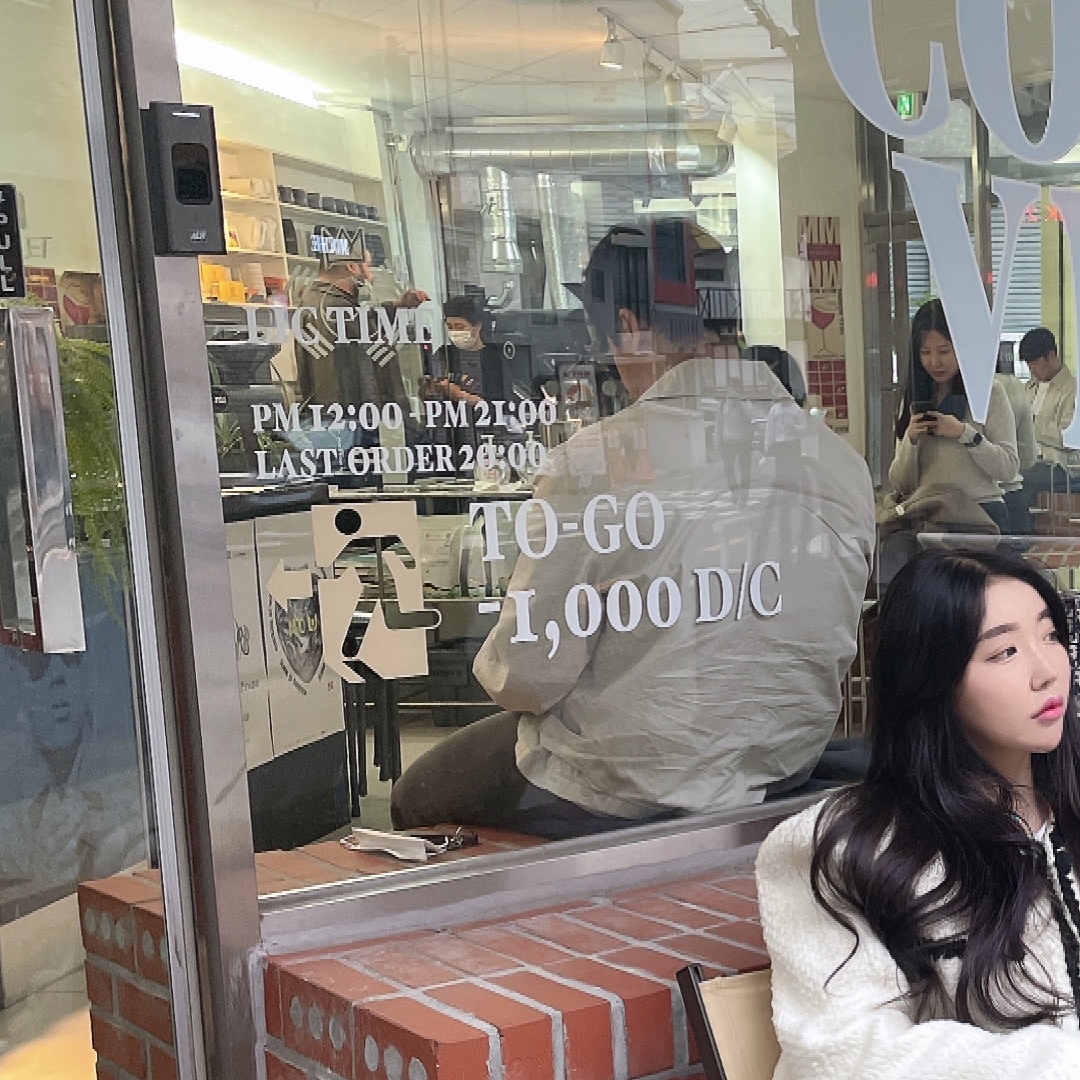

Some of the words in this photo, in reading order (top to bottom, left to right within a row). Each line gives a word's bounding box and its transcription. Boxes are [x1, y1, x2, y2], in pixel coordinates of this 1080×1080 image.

[250, 404, 302, 433] PM
[307, 402, 403, 431] 12:00
[424, 400, 468, 428] PM
[474, 400, 558, 427] 21:00
[254, 448, 340, 480] LAST
[347, 445, 456, 476] ORDER
[469, 491, 666, 561] TO-GO
[693, 561, 783, 624] D/C
